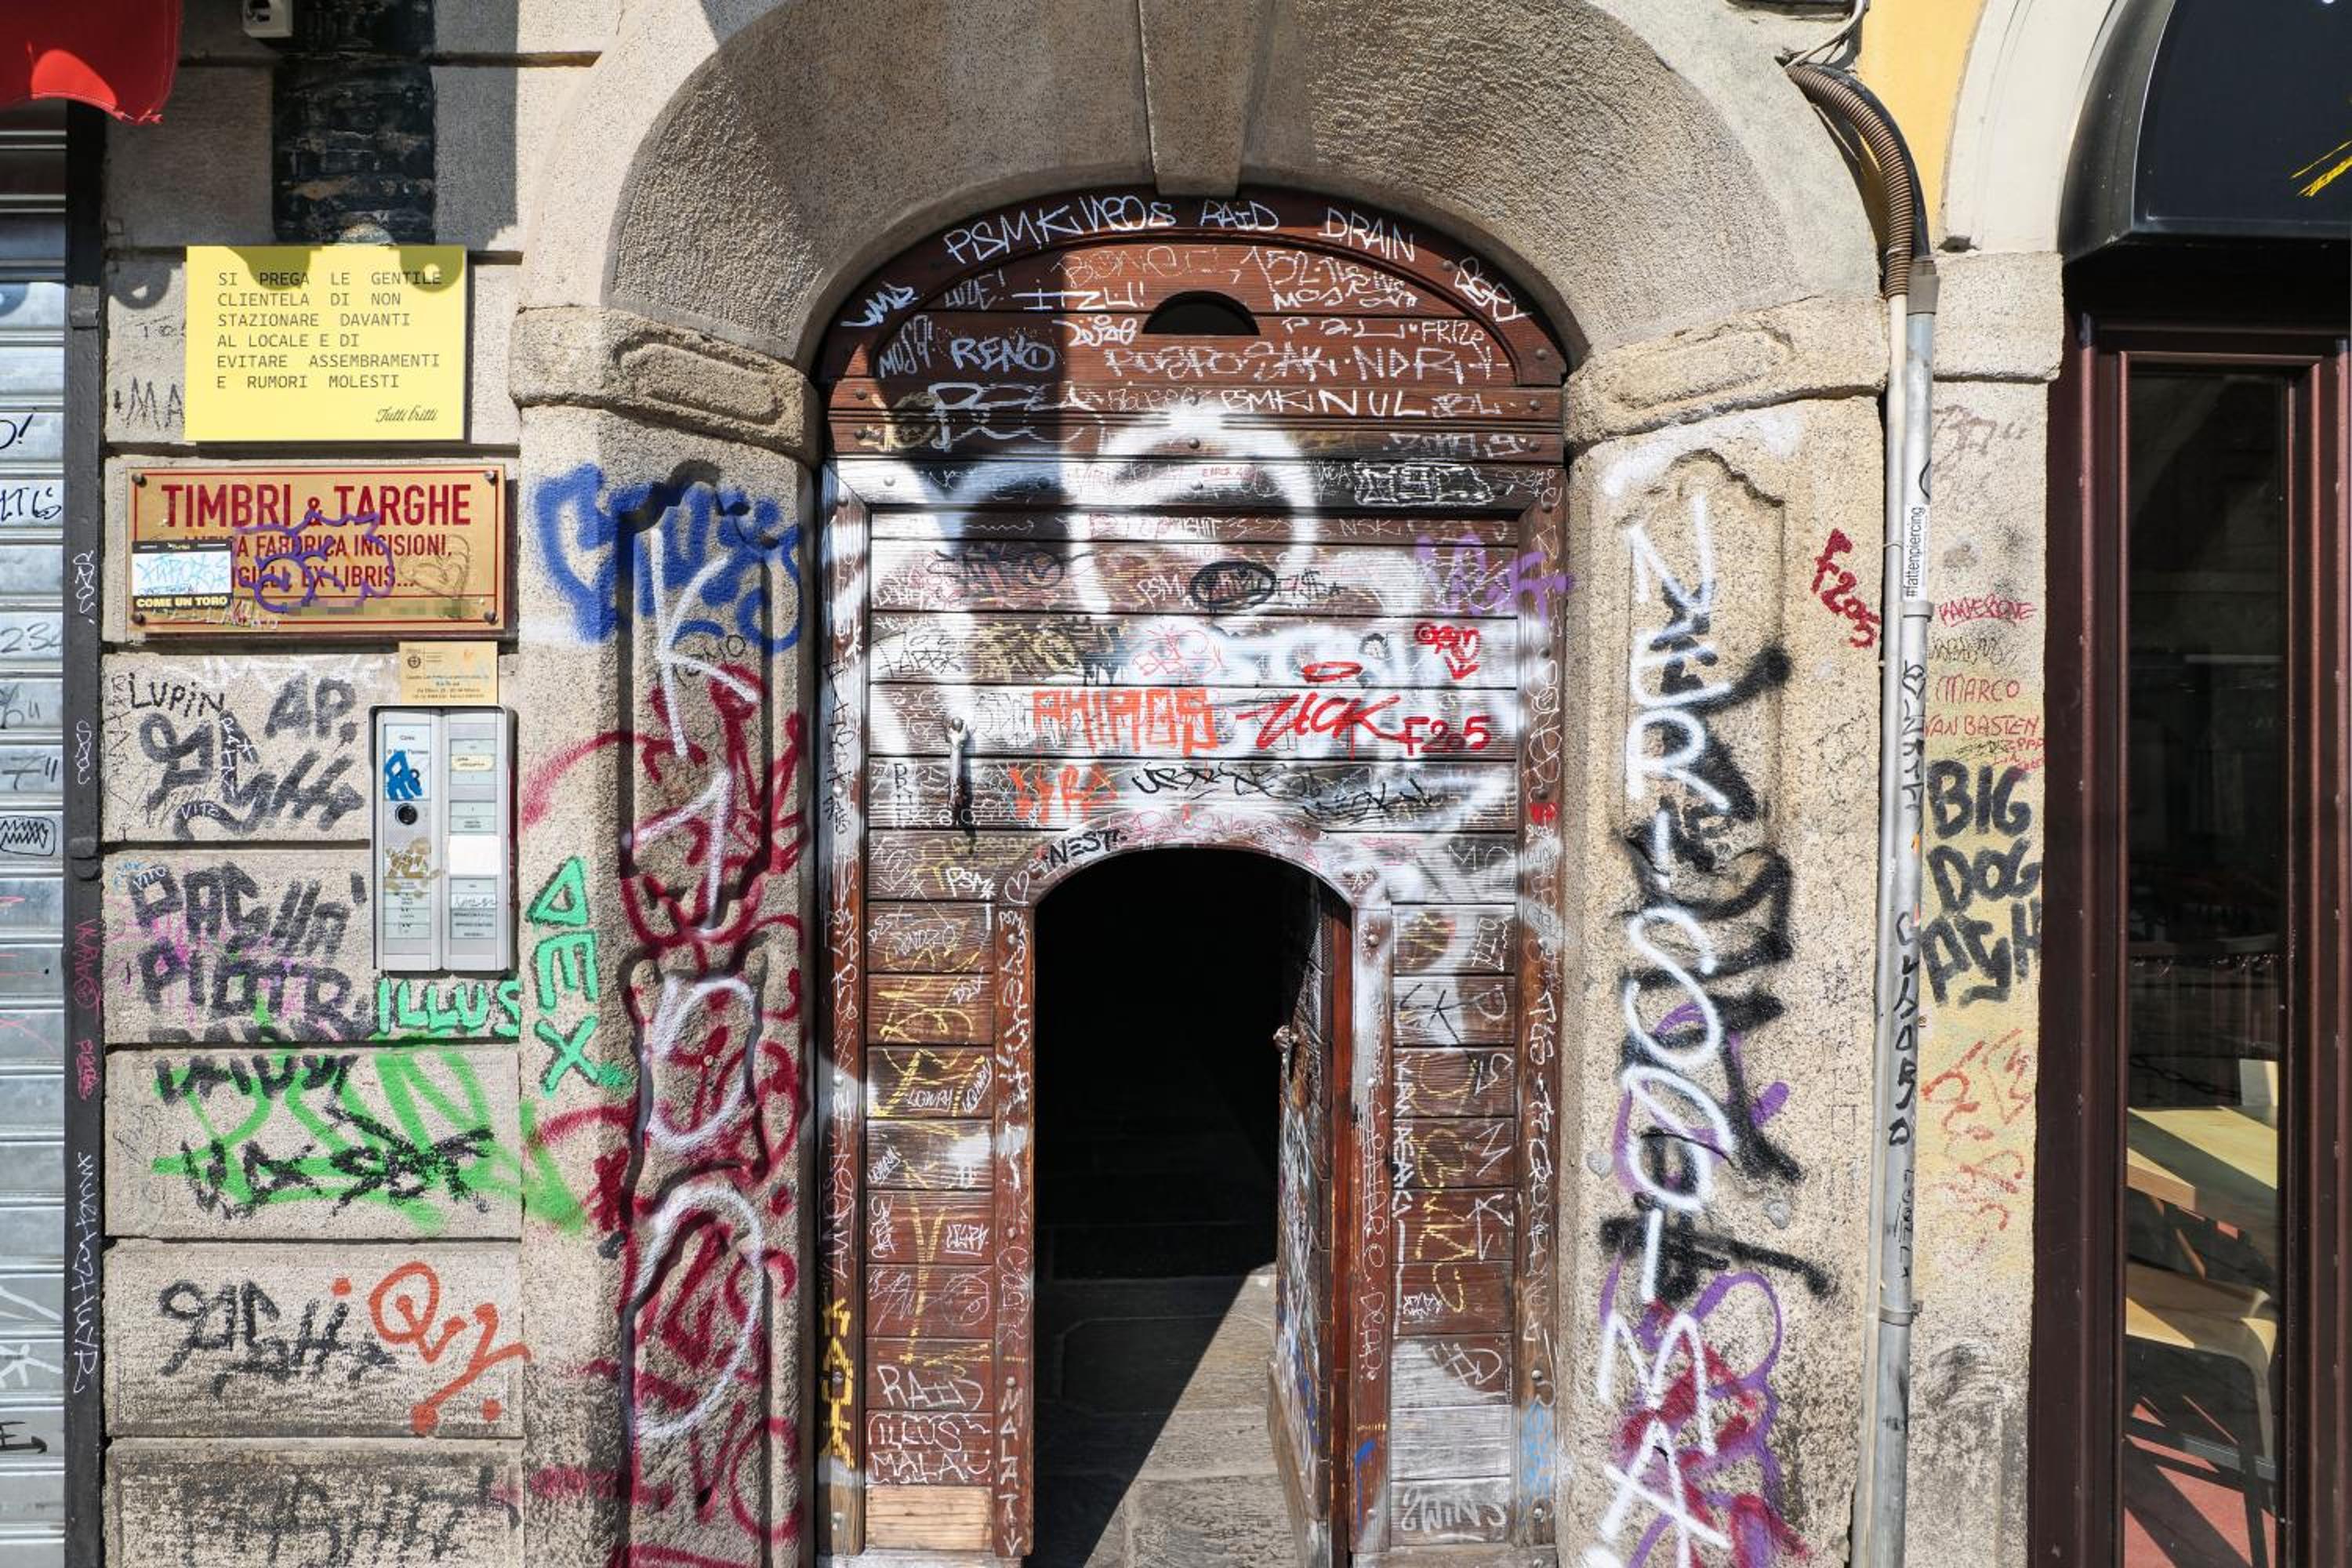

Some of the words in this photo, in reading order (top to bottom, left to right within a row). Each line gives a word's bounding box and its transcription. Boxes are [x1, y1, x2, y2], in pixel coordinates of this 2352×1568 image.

[219, 272, 238, 286] SI
[260, 272, 310, 286] PREGA
[331, 272, 350, 286] LE
[371, 271, 442, 285] GENTILE
[218, 292, 310, 307] CLIENTELA
[330, 292, 350, 306] DI
[371, 292, 401, 306] NON
[218, 314, 319, 327] STAZIONARE
[340, 313, 411, 326] DAVANTI
[217, 334, 237, 347] AL
[248, 334, 308, 347] LOCALE
[319, 333, 329, 347] E
[339, 333, 360, 347] DI
[217, 354, 289, 368] EVITARE
[309, 354, 440, 368] ASSEMBRAMENTI
[217, 376, 226, 390] E
[247, 376, 308, 389] RUMORI
[329, 374, 399, 388] MOLESTI
[162, 484, 291, 528] TIMBRI
[298, 497, 324, 526] &
[334, 484, 472, 526] TARGHE
[256, 535, 347, 556] FABBRICA
[354, 533, 452, 557] INCISIONI,
[136, 598, 172, 608] COME
[175, 597, 194, 607] UN
[195, 596, 227, 606] TORO
[1935, 673, 2020, 704] MARCO
[1964, 714, 2040, 737] BASTEN
[1926, 758, 2034, 839] BIG
[1927, 837, 2042, 916] DOG
[376, 974, 523, 1039] ILLUS
